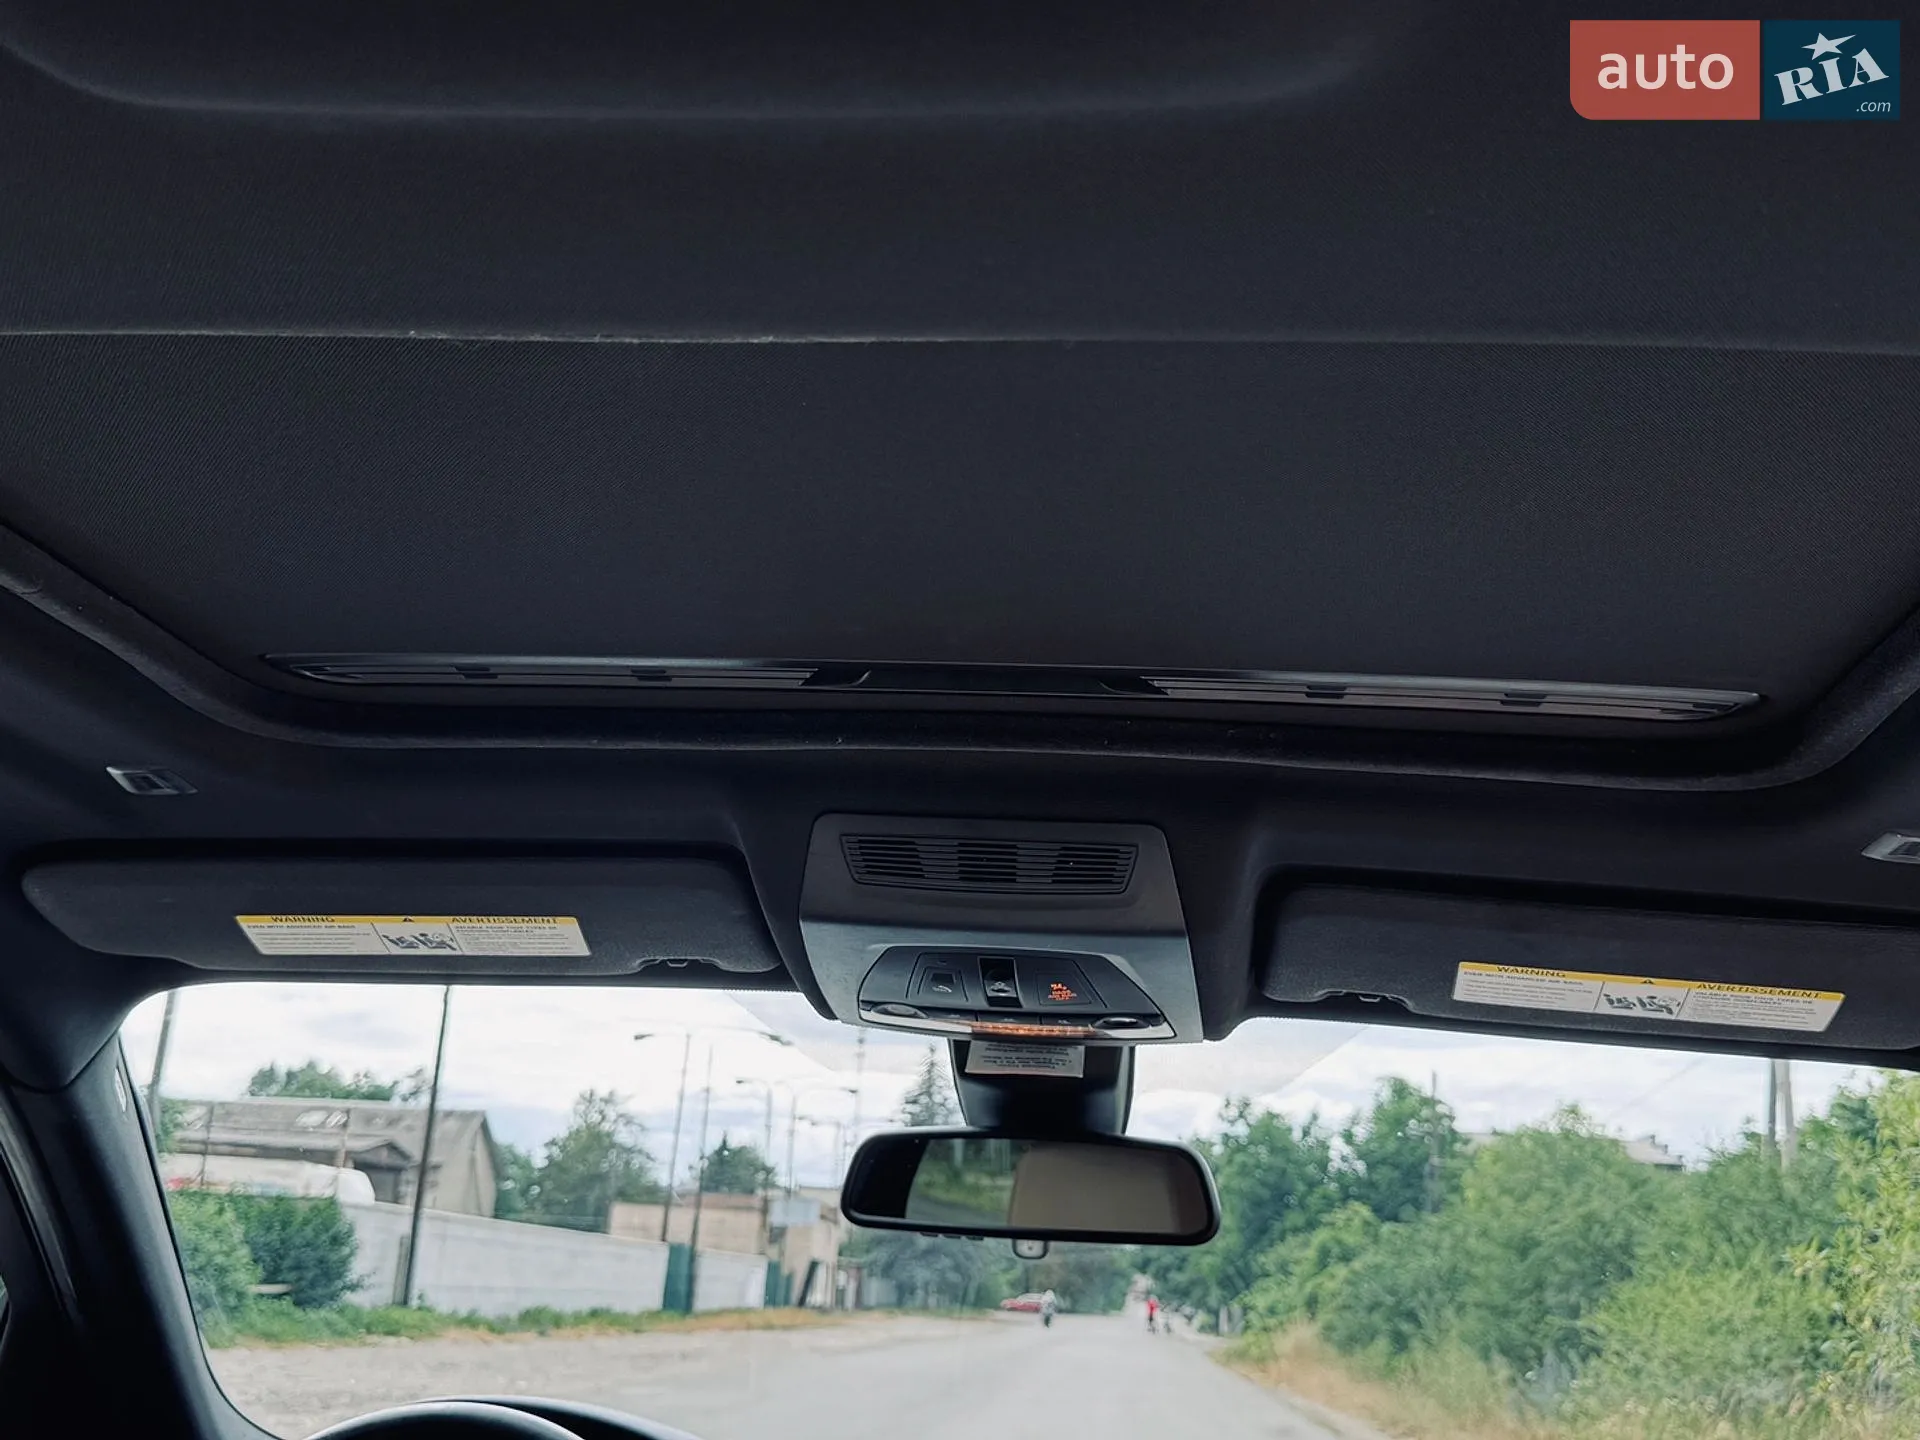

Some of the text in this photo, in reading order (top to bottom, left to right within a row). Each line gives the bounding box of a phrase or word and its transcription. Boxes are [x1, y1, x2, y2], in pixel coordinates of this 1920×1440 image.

[271, 915, 336, 923] WARNING
[1496, 965, 1566, 978] WARNING
[1696, 983, 1822, 999] AVERTISSEMENT
